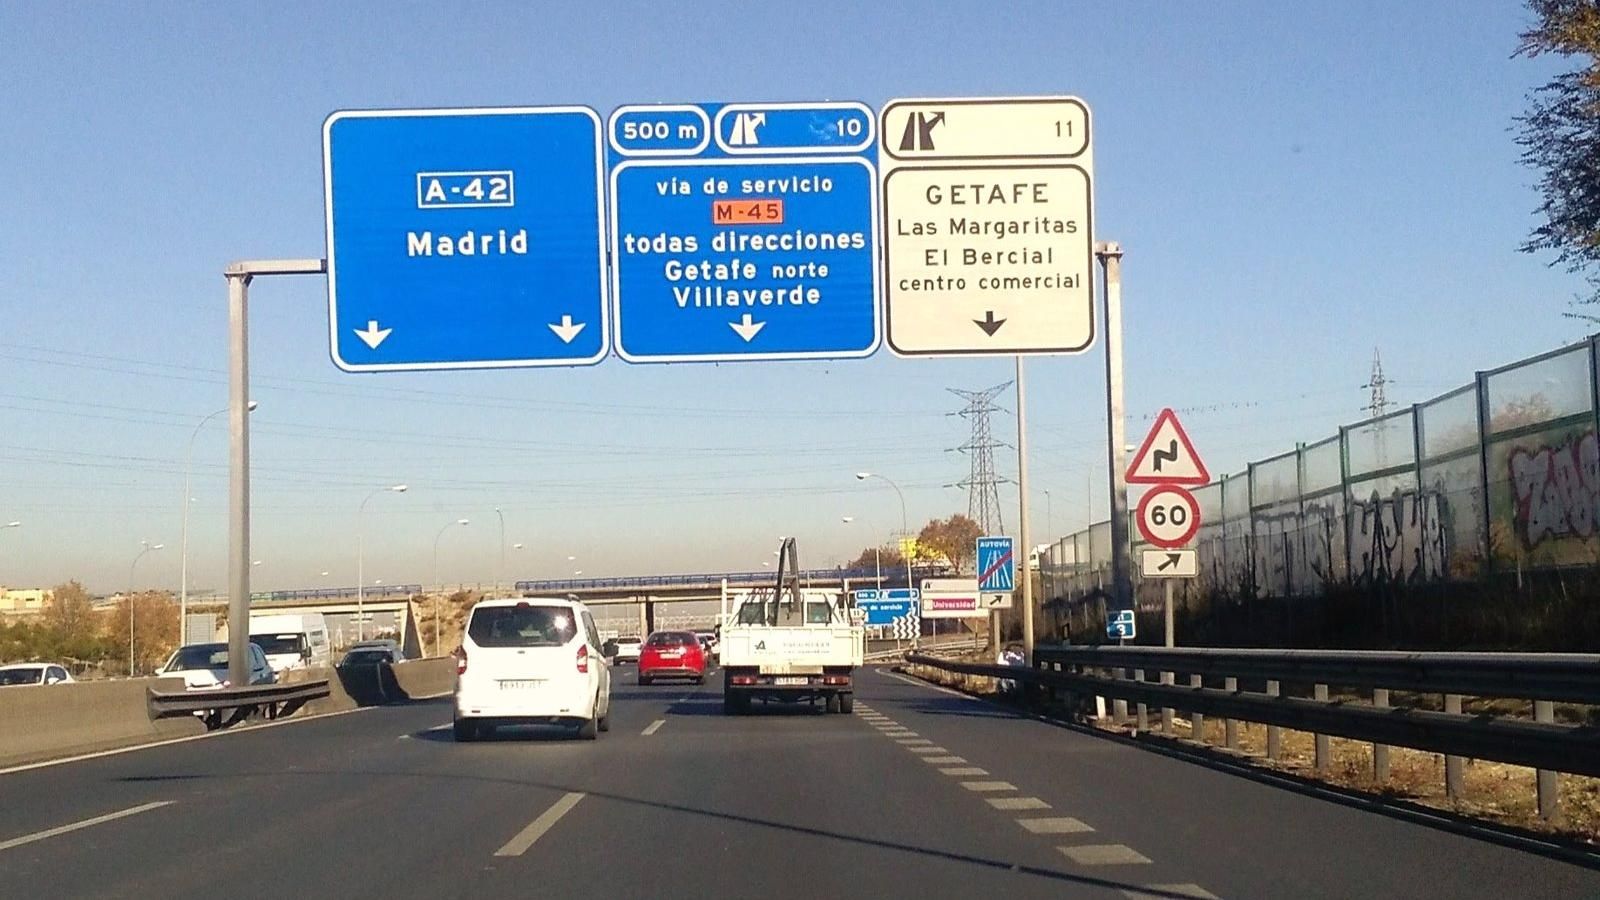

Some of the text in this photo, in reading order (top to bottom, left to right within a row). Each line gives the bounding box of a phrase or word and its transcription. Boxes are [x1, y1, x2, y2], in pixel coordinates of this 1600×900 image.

[624, 121, 698, 139] 500 m
[836, 119, 861, 136] 10
[1055, 120, 1073, 137] 11
[425, 178, 507, 201] A-42
[656, 175, 833, 195] vía de servicio
[926, 182, 1049, 205] GETAFE
[716, 203, 779, 220] M-45
[897, 216, 1077, 239] Las Margaritas
[407, 229, 528, 256] Madrid
[624, 230, 865, 253] todas direcciones
[925, 247, 1052, 266] El Bercial
[665, 259, 828, 281] Getafe norte
[899, 273, 1080, 291] centro comercial
[672, 285, 821, 307] Villaverde
[1151, 505, 1187, 526] 60
